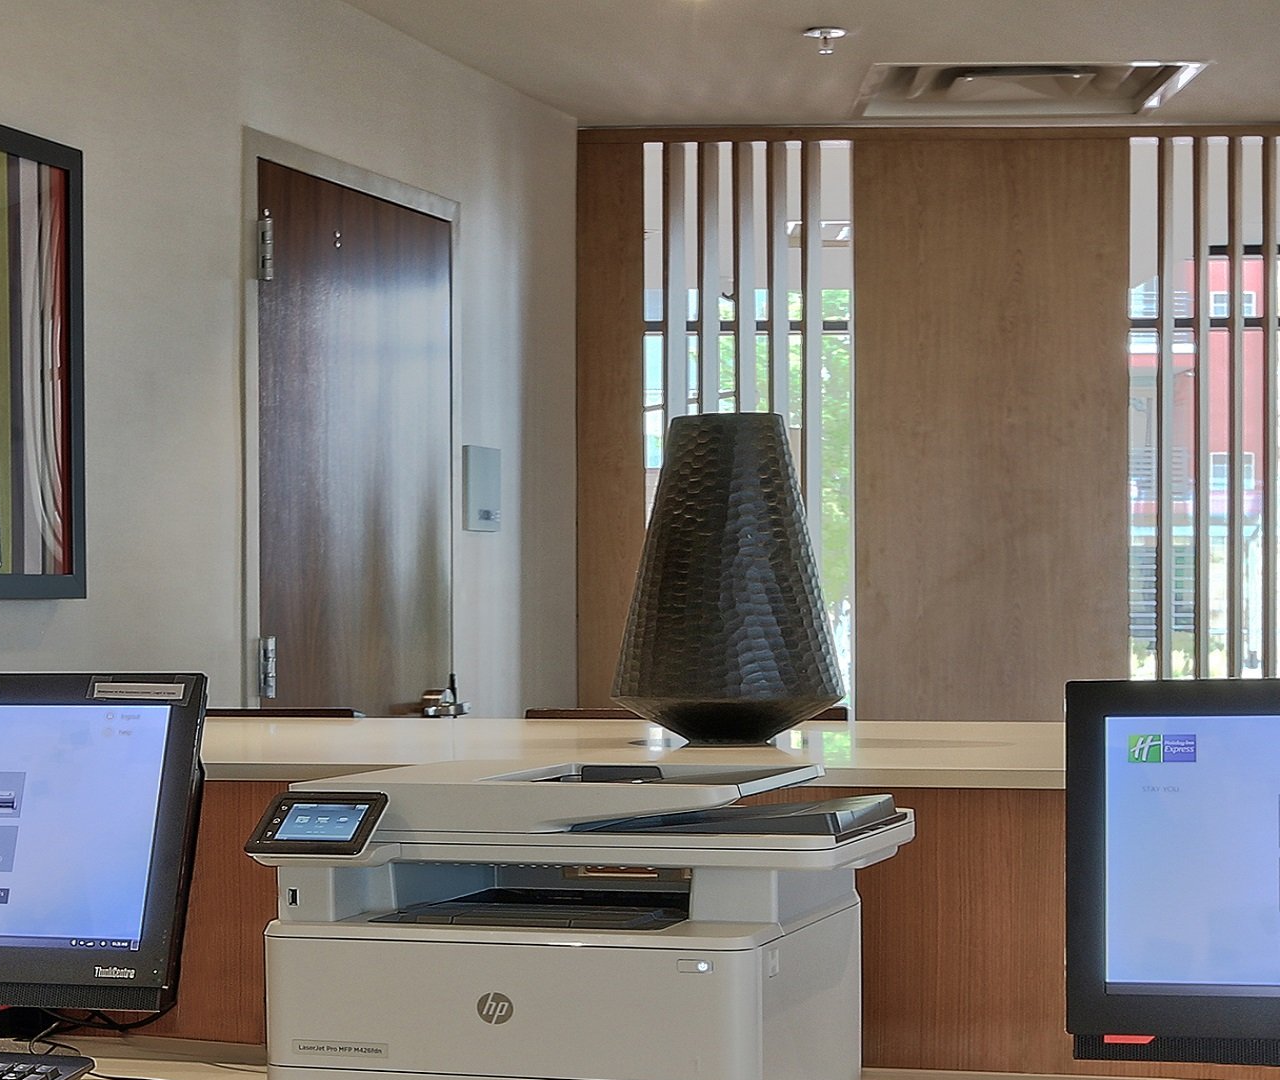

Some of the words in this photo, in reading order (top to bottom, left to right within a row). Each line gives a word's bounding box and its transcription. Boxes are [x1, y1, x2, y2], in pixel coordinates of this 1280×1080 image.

[1164, 746, 1195, 754] Express
[94, 966, 136, 978] ThinkCentre
[482, 992, 509, 1024] hp
[299, 1044, 325, 1052] LaserJet
